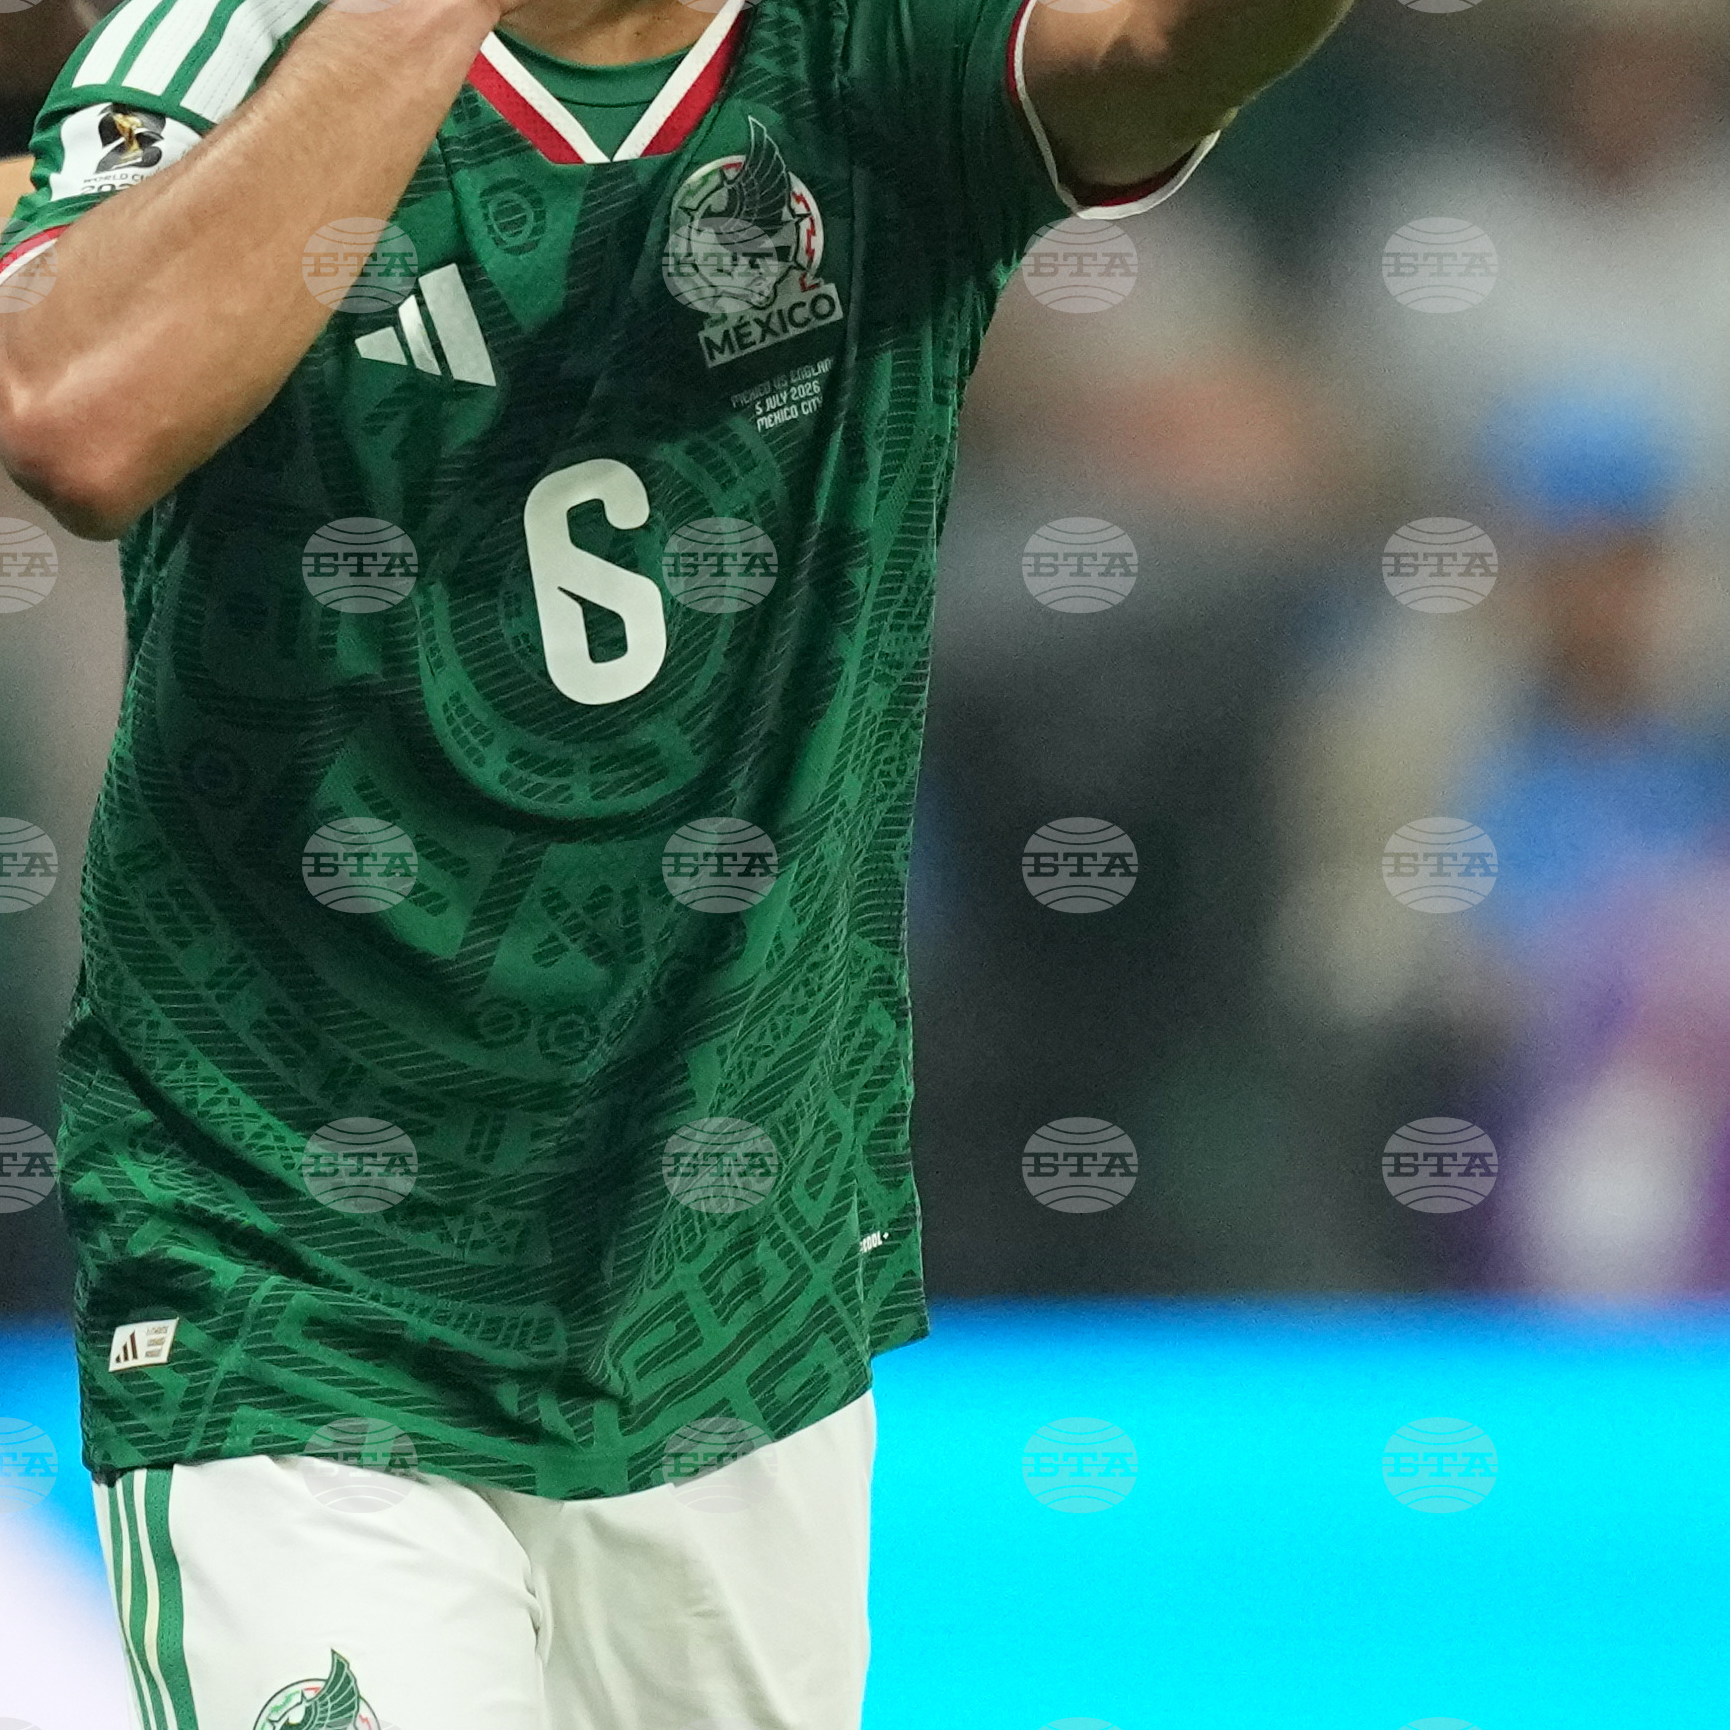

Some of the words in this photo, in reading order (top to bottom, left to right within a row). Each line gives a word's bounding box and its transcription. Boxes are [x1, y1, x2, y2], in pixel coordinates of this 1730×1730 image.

[703, 293, 837, 363] MÉXICO
[755, 401, 763, 415] 5
[765, 390, 788, 412] JULY
[790, 380, 821, 401] 2026
[756, 404, 799, 433] MEXICO
[801, 395, 823, 415] CITY
[523, 458, 667, 706] 6
